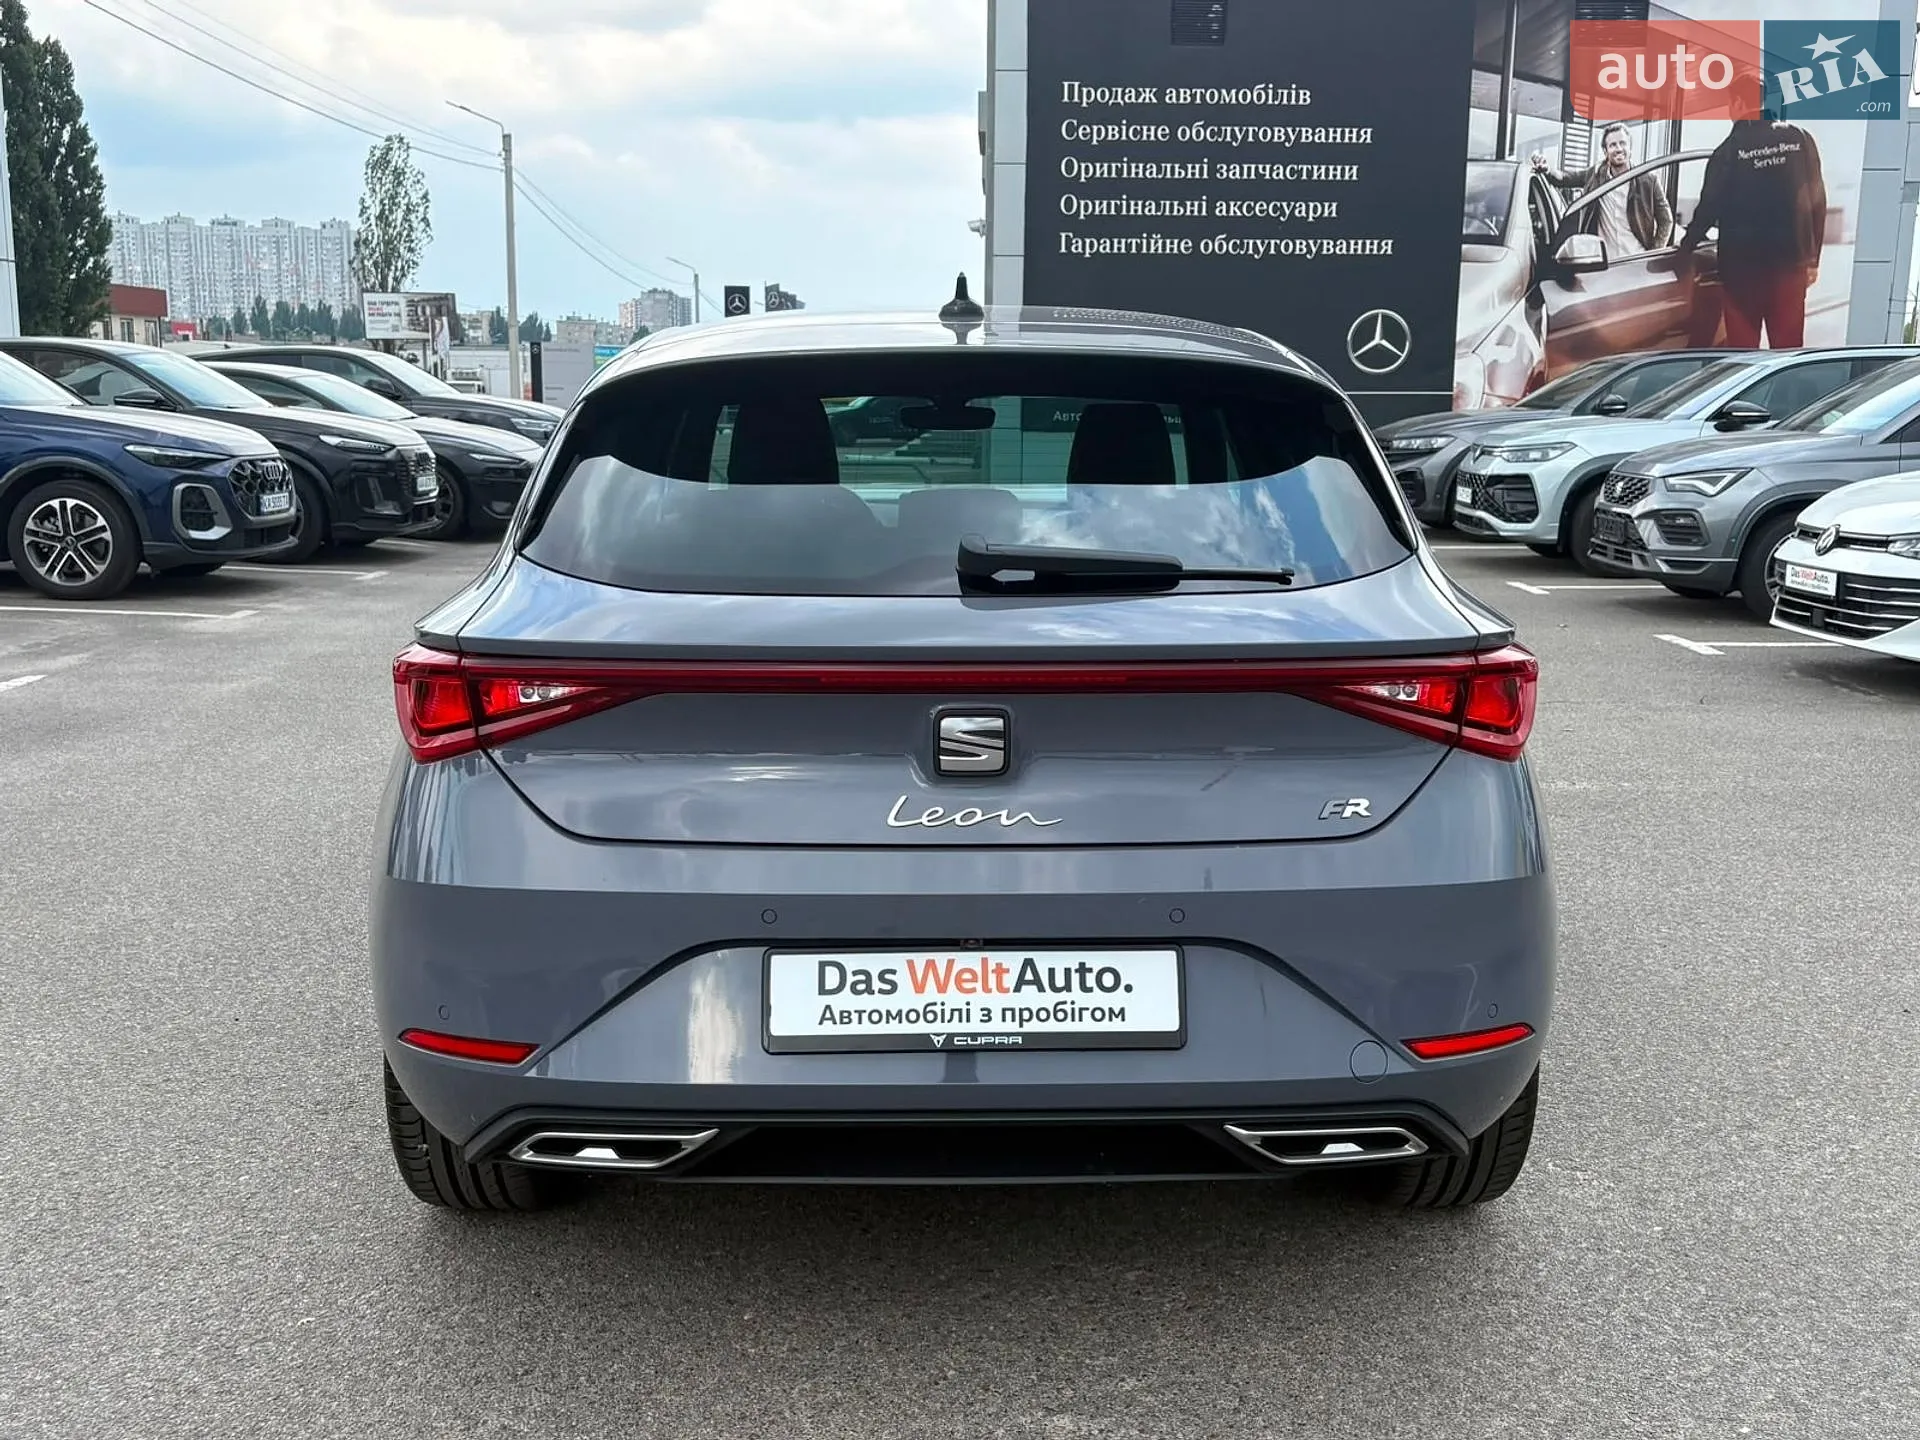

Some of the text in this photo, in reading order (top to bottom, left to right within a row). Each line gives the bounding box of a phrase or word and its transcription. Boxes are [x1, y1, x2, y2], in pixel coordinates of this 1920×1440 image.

[1061, 81, 1312, 107] Продаж автомобілів
[1060, 119, 1373, 148] Сервісне обслуговування
[1737, 143, 1801, 160] Mercedes-Benz
[1753, 156, 1786, 169] Service
[1060, 156, 1359, 182] Оригінальні запчастини
[1060, 194, 1338, 222] Оригінальні аксесуари
[1059, 232, 1393, 260] Гарантійне обслуговування
[887, 794, 1063, 827] Leon
[1319, 798, 1372, 820] FR
[817, 959, 898, 996] Das
[818, 1000, 1126, 1028] Автомобілі з пробігом
[953, 1036, 1023, 1046] CUPRA
